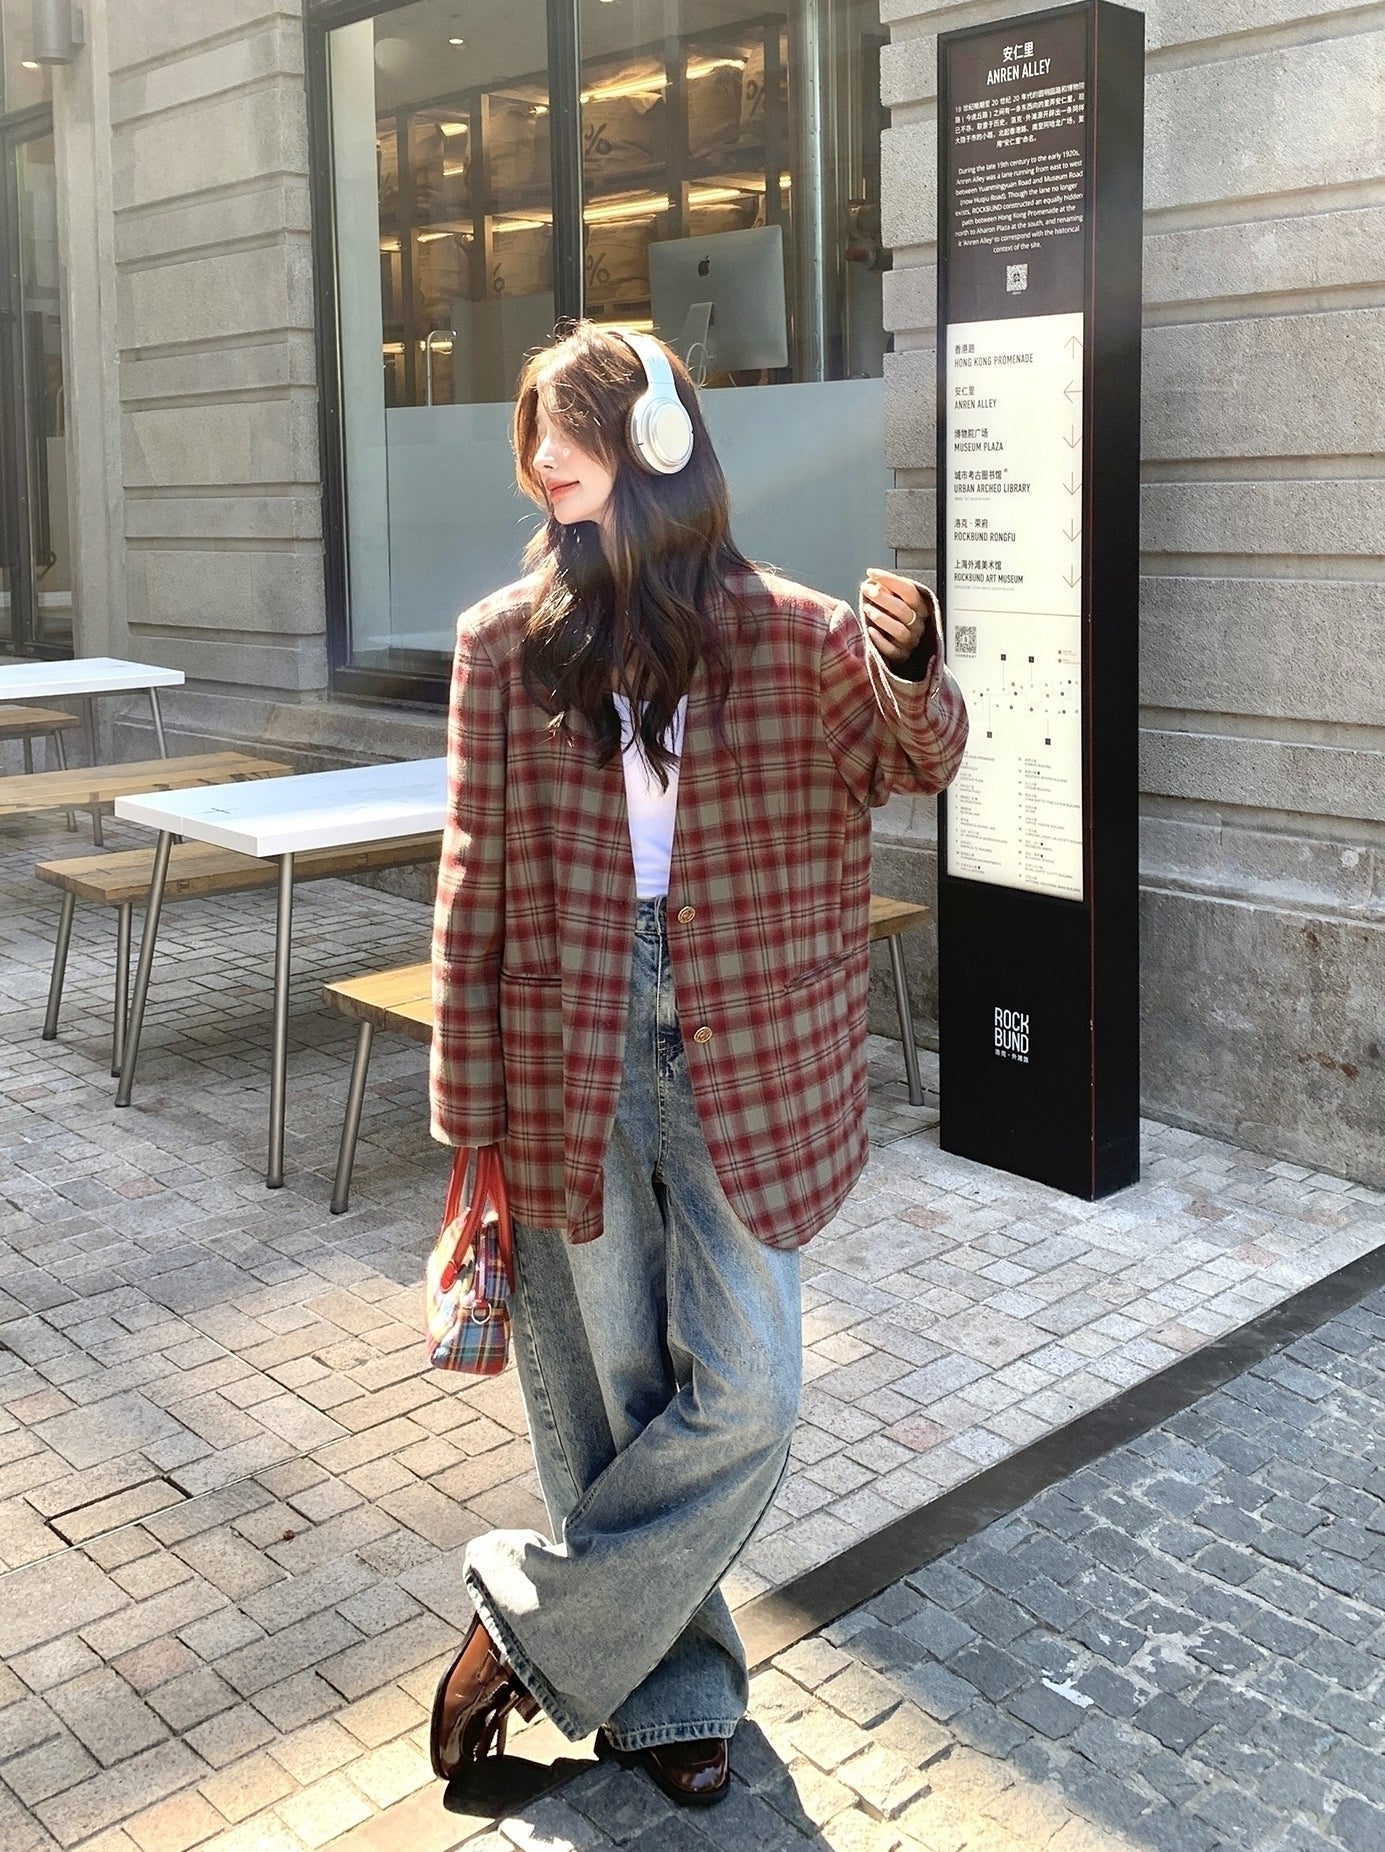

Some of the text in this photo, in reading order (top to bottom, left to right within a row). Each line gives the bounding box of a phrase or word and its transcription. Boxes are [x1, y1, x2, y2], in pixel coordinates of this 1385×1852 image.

[1003, 41, 1034, 62] 安仁里
[986, 58, 1051, 85] ANREN ALLEY
[955, 105, 961, 113] 19
[991, 98, 998, 106] 20
[1012, 94, 1020, 102] 20
[955, 177, 971, 185] Anren
[972, 174, 984, 184] Alley
[1001, 170, 1012, 178] lane
[1013, 167, 1034, 178] running
[1035, 164, 1049, 172] from
[1069, 159, 1082, 167] west
[958, 165, 975, 176] During
[976, 164, 985, 172] the
[985, 162, 996, 170] late
[997, 160, 1009, 168] 19th
[1009, 158, 1029, 168] century
[1037, 154, 1046, 162] the
[1047, 151, 1061, 161] early
[955, 169, 1083, 195] between Yuanmingyuan Road and Museum Road
[959, 198, 973, 206] (now
[973, 195, 989, 204] Huqiu
[1007, 189, 1028, 200] Though
[1028, 187, 1038, 195] the
[1038, 185, 1050, 194] lane
[1059, 181, 1077, 192] longer
[971, 203, 1002, 214] ROCKBUND
[1002, 198, 1034, 209] constructed
[1043, 195, 1062, 205] equally
[1063, 191, 1083, 201] hidden
[961, 218, 973, 227] path
[974, 215, 996, 224] between
[997, 213, 1012, 222] Hong
[1012, 211, 1026, 220] Kong
[1027, 206, 1058, 216] Promenade
[1066, 203, 1075, 211] the
[954, 229, 969, 237] north
[976, 225, 995, 234] Aharon
[996, 223, 1010, 231] Plaza
[1017, 221, 1026, 229] the
[1044, 217, 1056, 225] and
[1056, 213, 1083, 225] renaming
[1000, 231, 1030, 243] correspond
[1031, 229, 1043, 237] with
[1044, 228, 1053, 236] the
[1054, 224, 1080, 234] historical
[993, 245, 1012, 253] context
[1020, 242, 1029, 250] the
[955, 343, 975, 354] 香港路
[954, 353, 1033, 368] HONG KONG PROMENADE
[955, 386, 975, 396] 安仁里
[954, 398, 997, 410] ANREN ALLEY
[954, 428, 988, 439] 博物院广场
[954, 442, 1004, 452] MUSEUM PLAZA
[954, 470, 1002, 480] 城市考古图书馆
[954, 483, 1031, 493] URBAN ARCHEO LIBRARY
[954, 532, 1016, 542] ROCKBUND RONGFU
[954, 560, 1002, 570] 上海外滩美术馆
[954, 573, 1024, 584] ROCKBUND ART MUSEUM
[994, 1006, 1029, 1035] ROCK
[994, 1027, 1029, 1054] BUND
